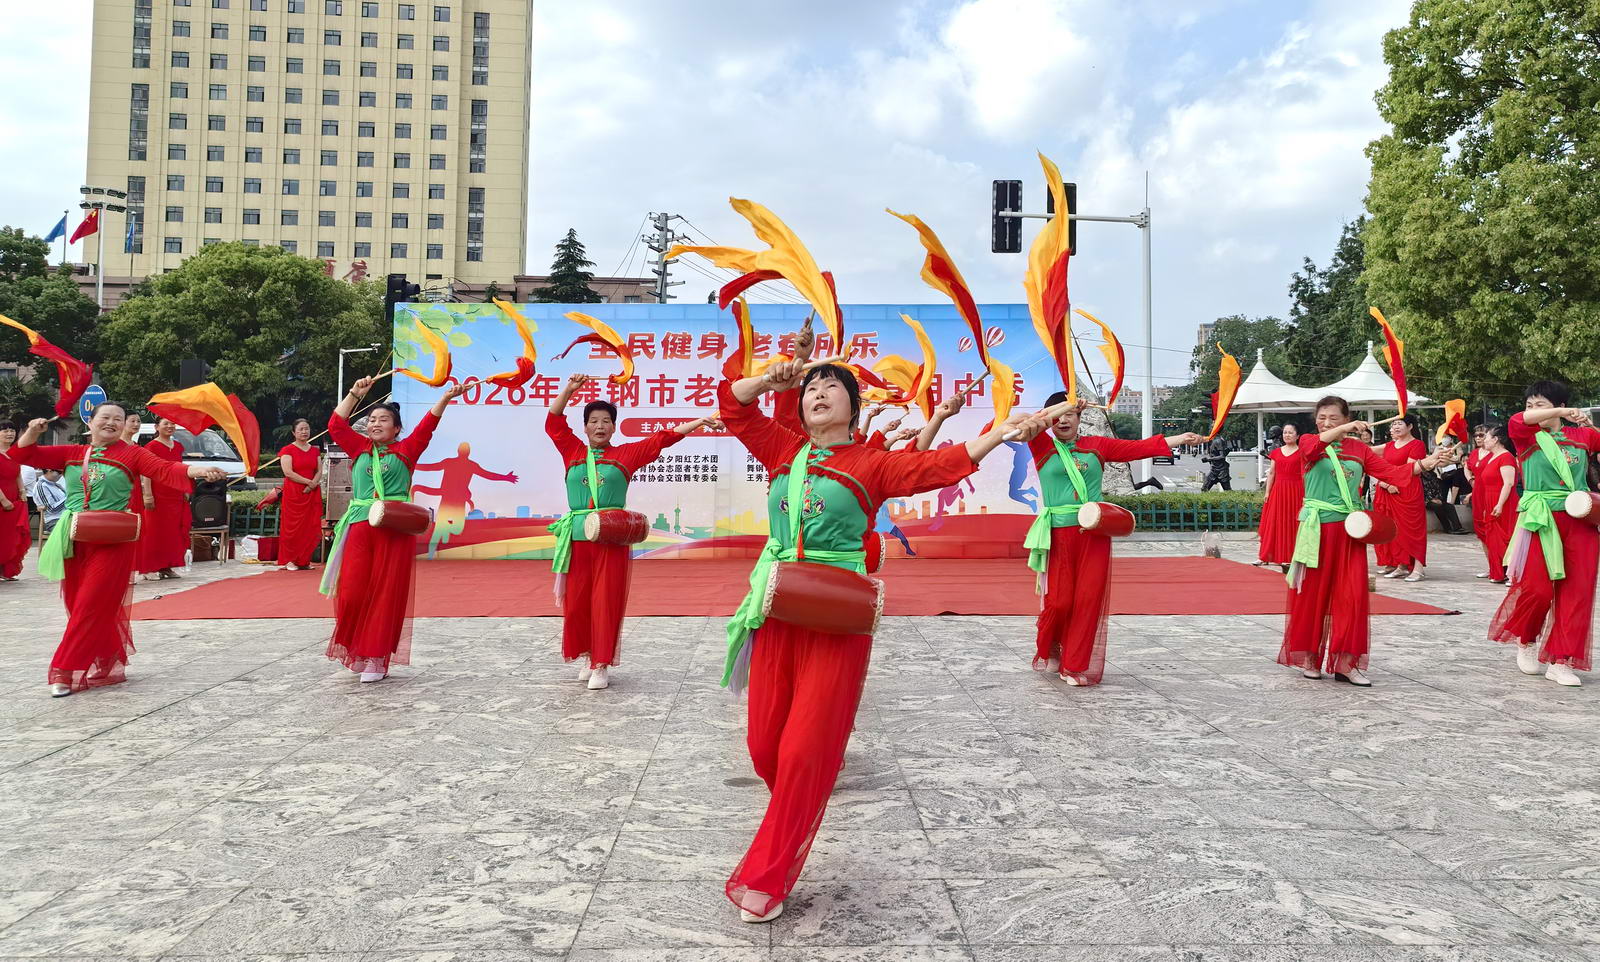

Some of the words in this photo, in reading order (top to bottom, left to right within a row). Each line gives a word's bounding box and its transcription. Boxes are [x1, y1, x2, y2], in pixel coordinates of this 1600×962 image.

[653, 454, 719, 463] 会夕阳红艺术团
[746, 464, 768, 472] 舞钢
